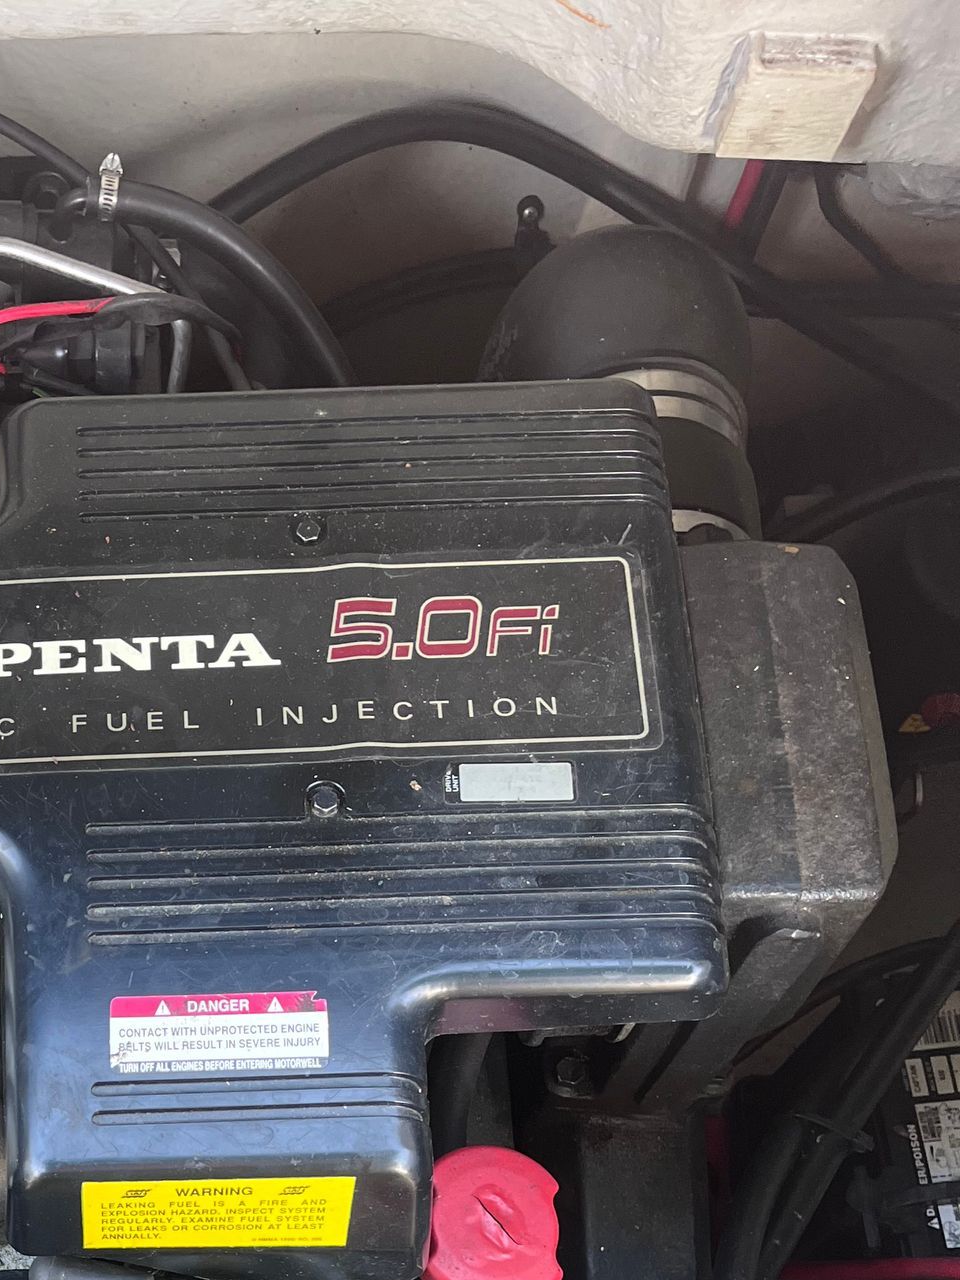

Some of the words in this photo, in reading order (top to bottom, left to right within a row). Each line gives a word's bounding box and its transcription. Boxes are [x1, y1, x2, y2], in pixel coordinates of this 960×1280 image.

[72, 709, 200, 734] FUEL
[256, 696, 558, 727] INJECTION
[187, 999, 250, 1013] DANGER
[119, 1027, 169, 1038] CONTACT
[171, 1026, 197, 1037] WITH
[200, 1024, 279, 1036] UNPROTECTED
[281, 1023, 320, 1034] ENGINE
[119, 1040, 151, 1052] BELTS
[154, 1040, 180, 1051] WILL
[182, 1039, 223, 1051] RESULT
[226, 1038, 236, 1049] IN
[238, 1037, 280, 1049] SEVERE
[283, 1036, 321, 1047] INJURY
[119, 1062, 139, 1073] TURN
[140, 1062, 154, 1072] OFF
[155, 1061, 170, 1072] ALL
[171, 1060, 204, 1072] ENGINES
[204, 1060, 235, 1071] BEFORE
[236, 1059, 274, 1070] ENTERING
[274, 1058, 321, 1069] MOTORWELL
[175, 1186, 253, 1197] WARNING
[101, 1201, 156, 1210] LEAKING
[301, 1198, 327, 1206] AND
[101, 1209, 166, 1217] EXPLOSION
[170, 1208, 220, 1216] HAZARD.
[226, 1207, 274, 1215] INSPECT
[193, 1223, 263, 1231] CORROSION
[287, 1222, 325, 1230] LEAST
[101, 1232, 162, 1240] ANNUALLY.
